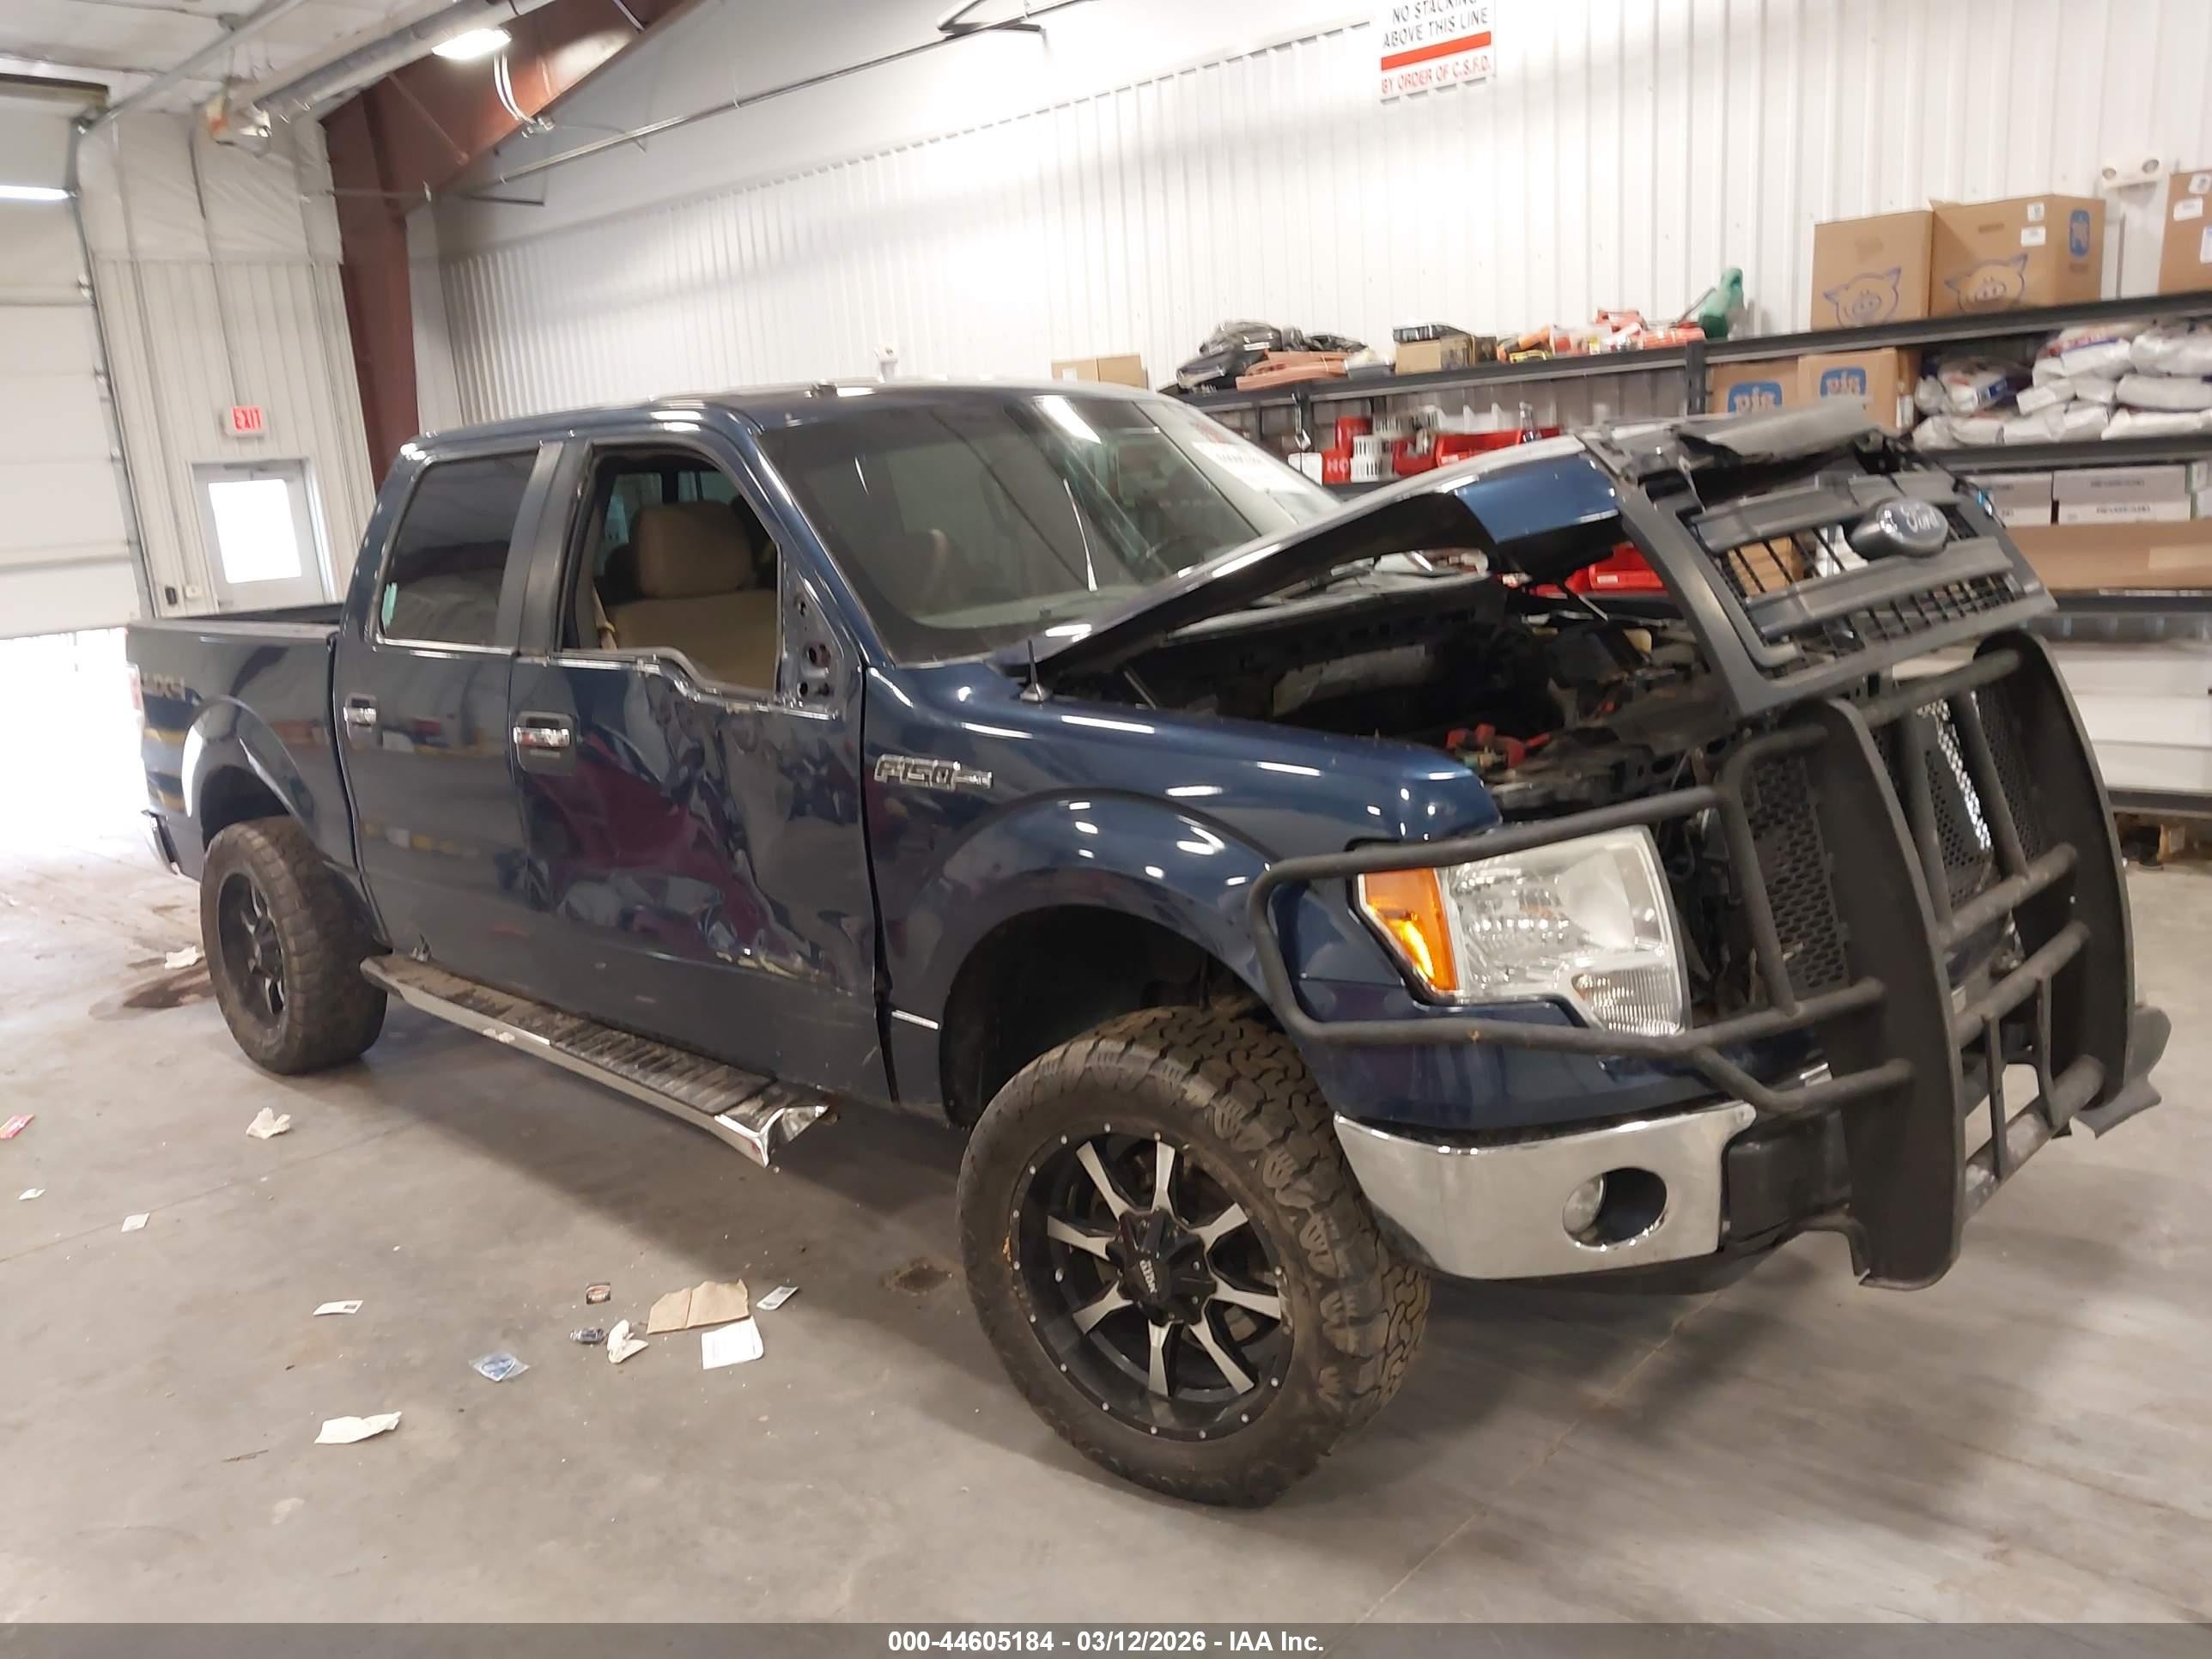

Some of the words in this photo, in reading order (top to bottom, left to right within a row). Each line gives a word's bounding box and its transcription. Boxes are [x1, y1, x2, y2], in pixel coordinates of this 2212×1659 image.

[1392, 5, 1409, 23] NO
[1415, 0, 1477, 19] STACK
[1382, 24, 1423, 48] ABOVE
[1429, 15, 1455, 36] THIS
[1461, 7, 1488, 29] LINE
[1382, 77, 1394, 94] BY
[1397, 68, 1432, 90] ORDER
[1436, 64, 1449, 82] OF
[234, 409, 261, 429] EXIT
